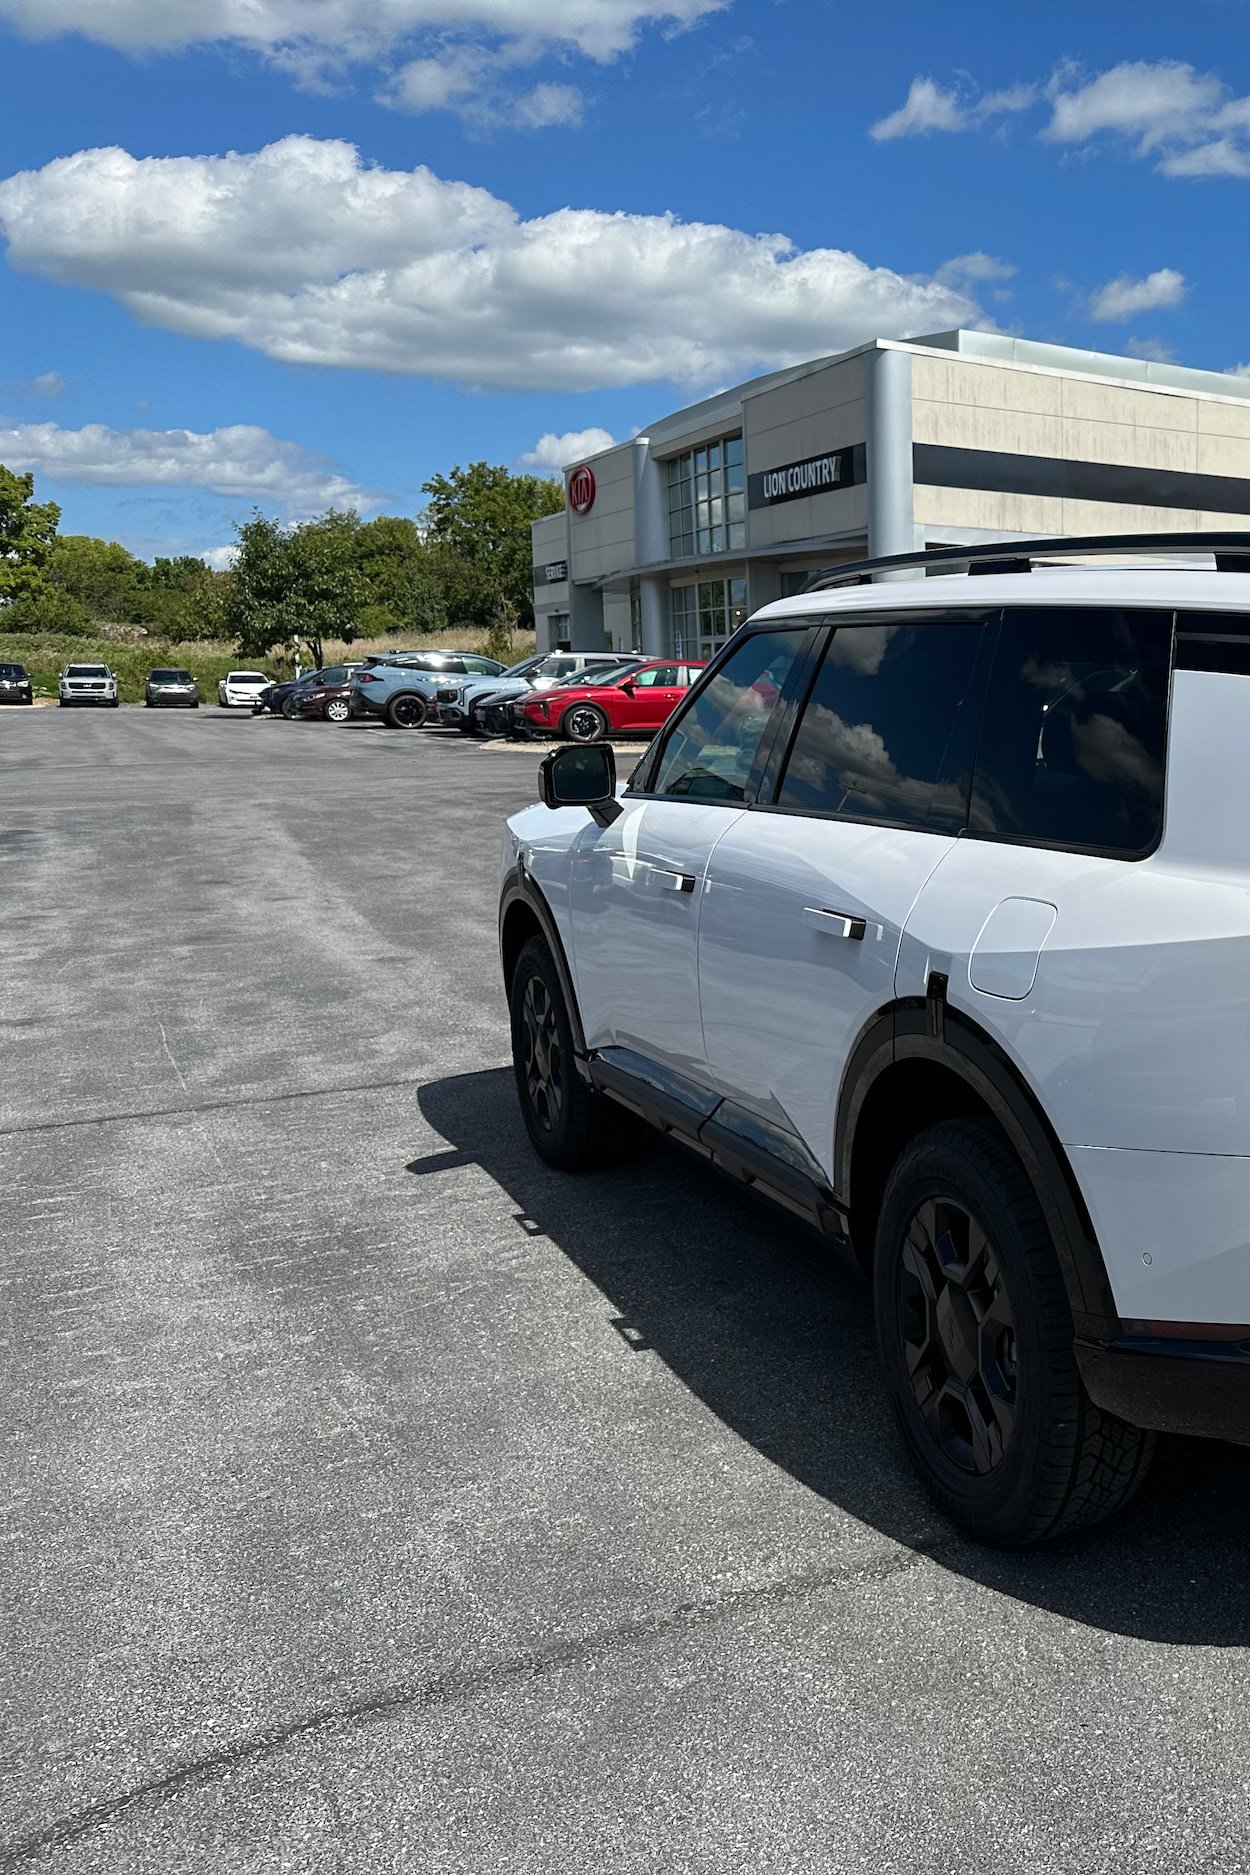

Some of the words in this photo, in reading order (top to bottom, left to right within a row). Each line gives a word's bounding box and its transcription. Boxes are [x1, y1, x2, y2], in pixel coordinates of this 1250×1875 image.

[571, 478, 588, 505] KIA
[763, 470, 786, 498] LION
[787, 456, 837, 492] COUNTRY
